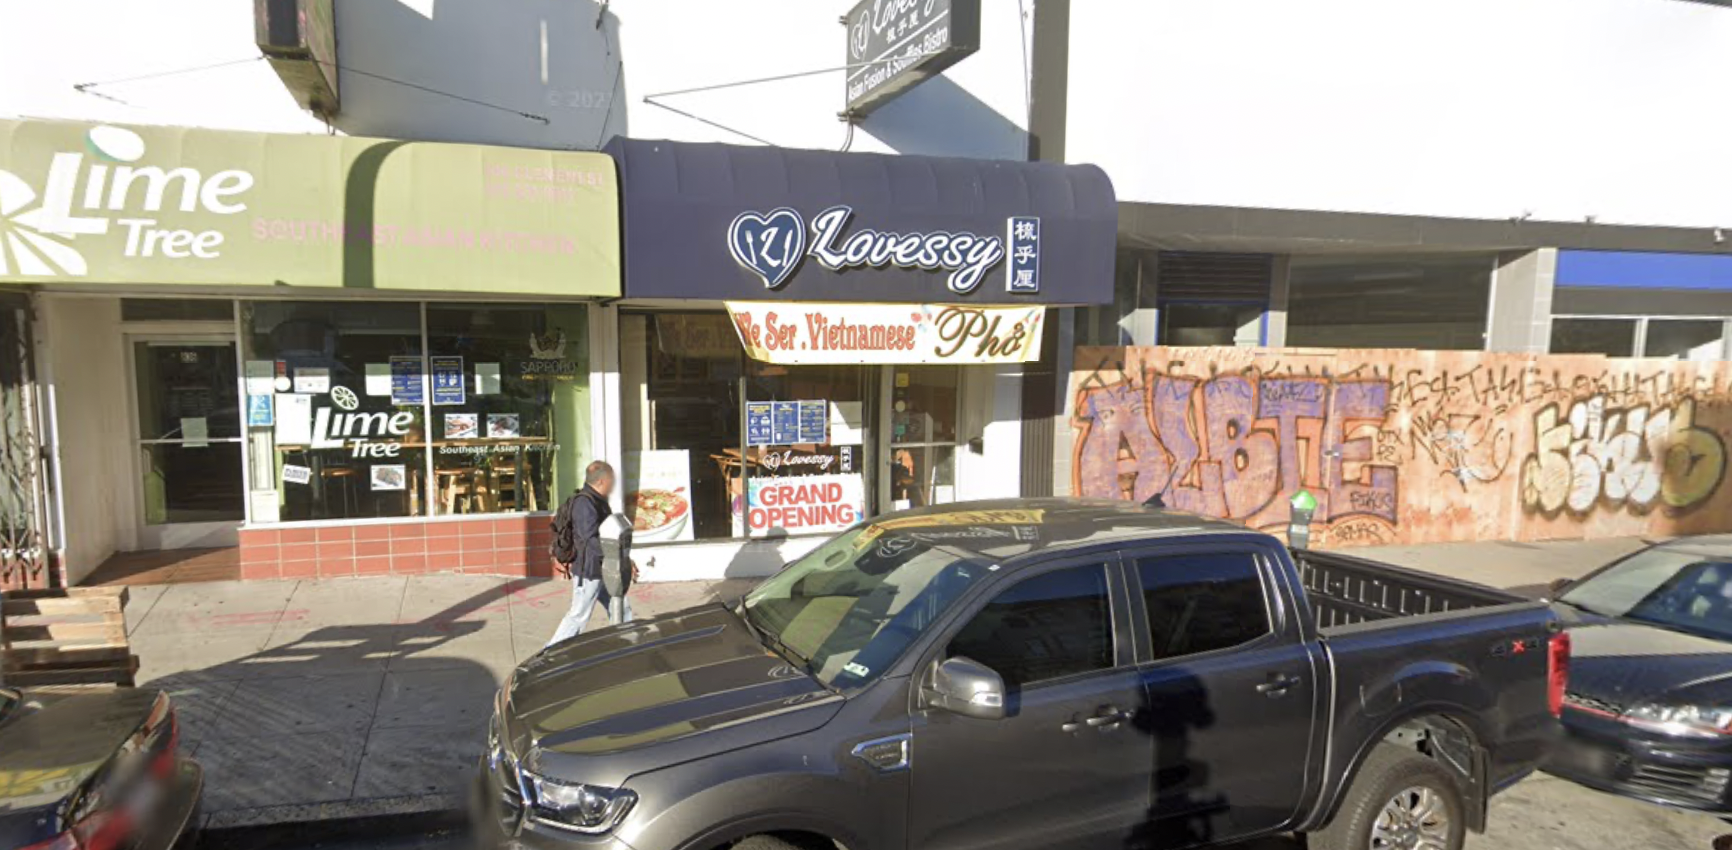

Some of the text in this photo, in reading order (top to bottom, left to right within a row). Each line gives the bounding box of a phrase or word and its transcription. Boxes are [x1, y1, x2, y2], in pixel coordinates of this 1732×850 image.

[923, 26, 948, 54] Bistro
[38, 153, 254, 236] Lime
[117, 218, 225, 259] Tree
[809, 206, 1003, 291] Lovessy
[1013, 221, 1038, 288] 梳乎厘
[520, 361, 577, 374] SAPPORO
[311, 406, 414, 449] Lime
[349, 438, 401, 458] Tree
[440, 445, 488, 455] Southeast
[493, 444, 520, 454] Asian
[783, 450, 834, 470] Lovessy
[759, 482, 843, 506] GRAND
[748, 503, 854, 529] OPENING
